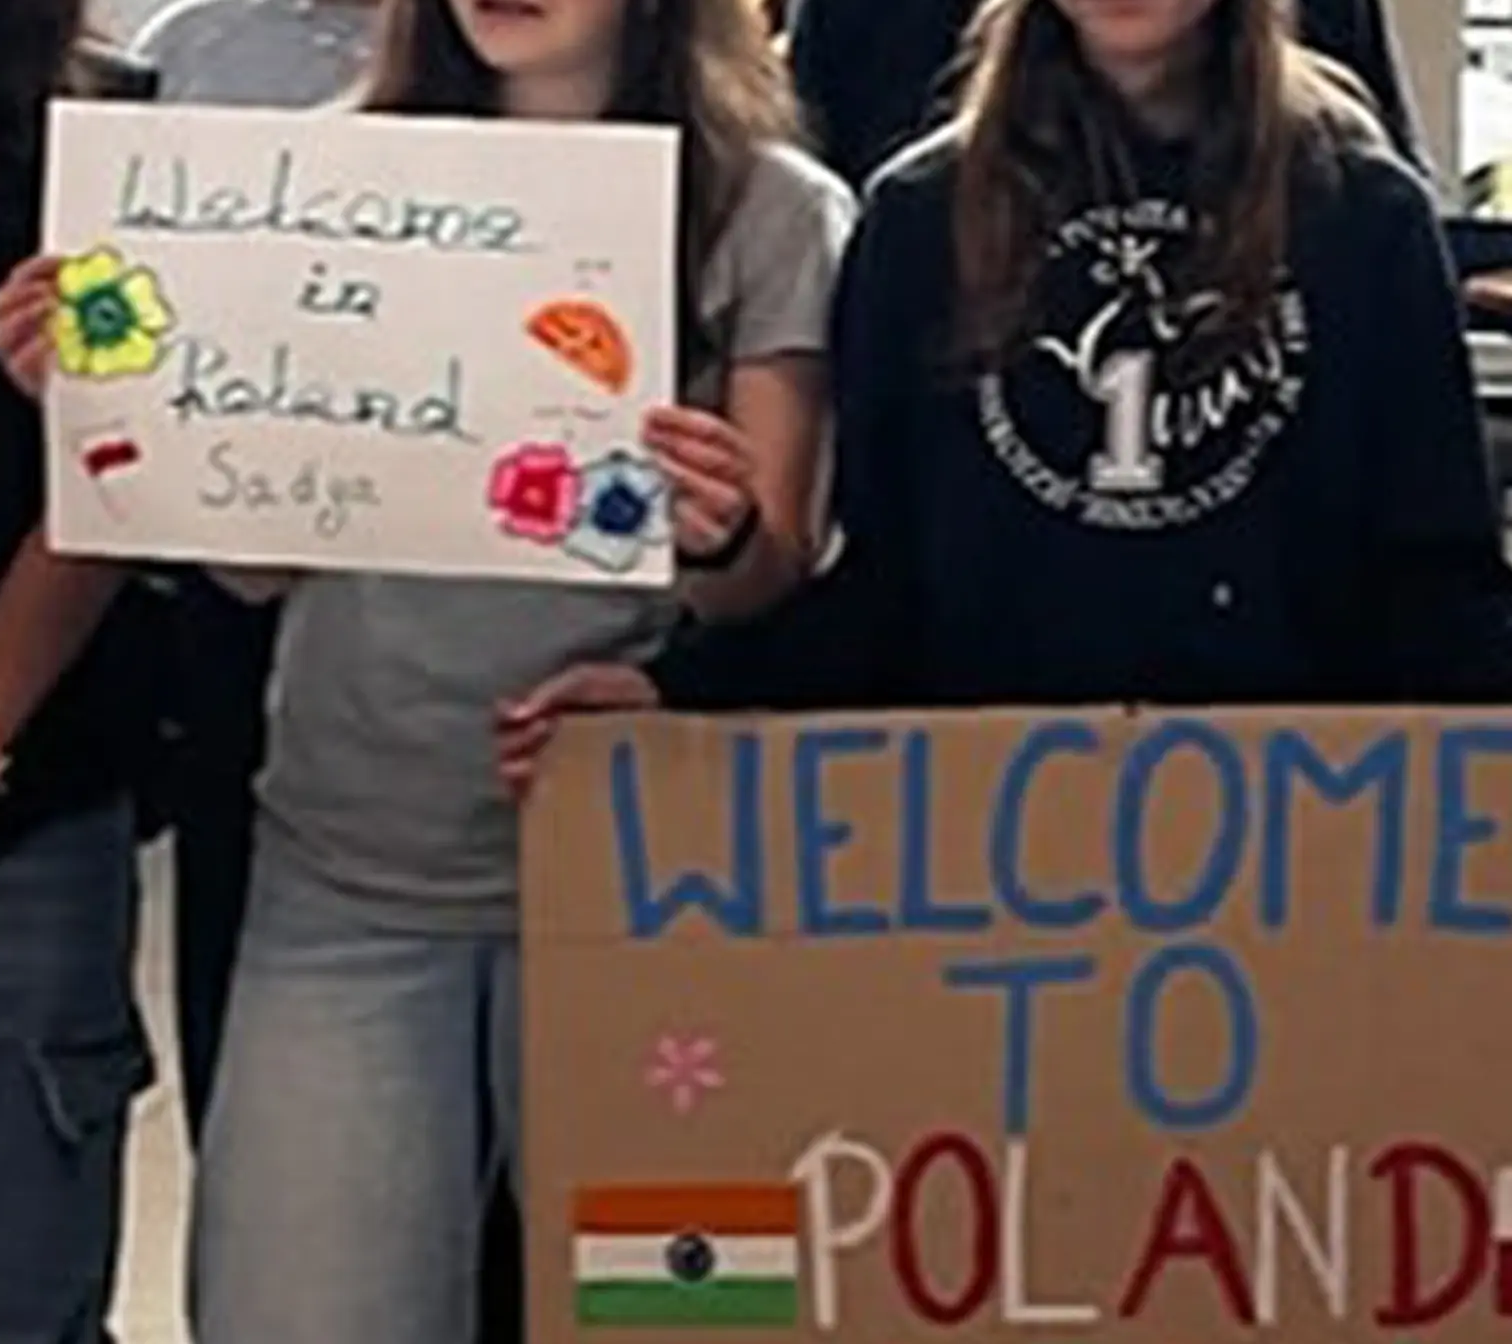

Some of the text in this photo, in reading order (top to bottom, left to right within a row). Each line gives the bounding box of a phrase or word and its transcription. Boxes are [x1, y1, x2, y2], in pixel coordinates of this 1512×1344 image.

[113, 149, 549, 253] Welcome
[297, 263, 384, 321] in
[165, 337, 483, 444] Poland
[942, 943, 1259, 1134] TO
[791, 1128, 1492, 1331] POLAND
